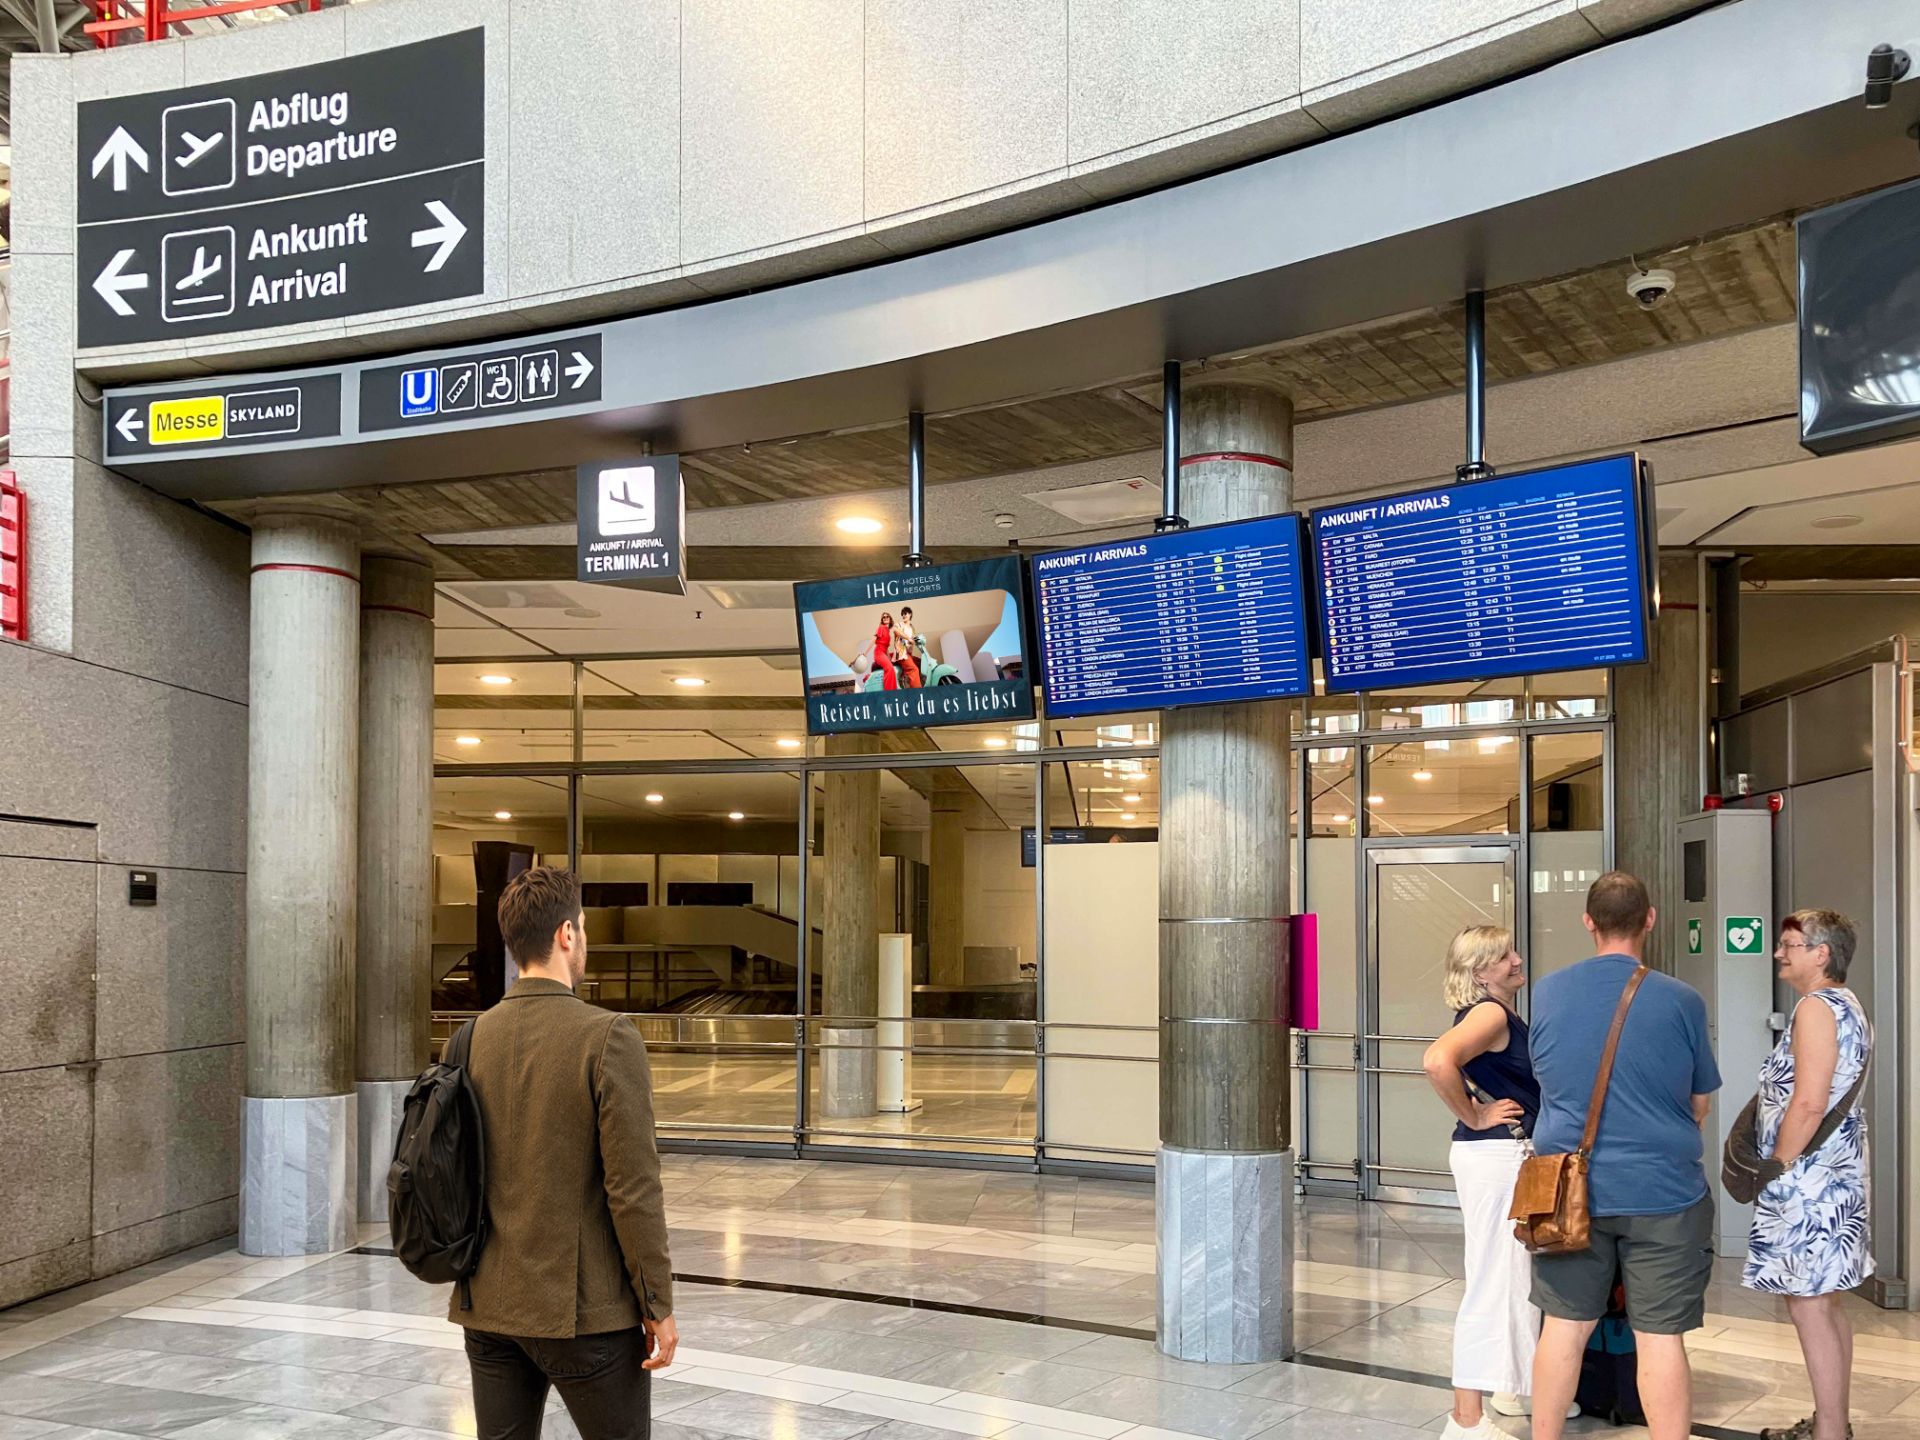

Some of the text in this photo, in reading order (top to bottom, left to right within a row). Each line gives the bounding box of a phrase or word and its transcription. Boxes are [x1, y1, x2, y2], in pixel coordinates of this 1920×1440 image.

[248, 92, 348, 132] Abflug
[247, 127, 397, 177] Departure
[248, 213, 368, 261] Ankunft
[248, 263, 347, 307] Arrival
[486, 366, 500, 375] WC
[407, 372, 432, 405] U
[157, 413, 218, 432] Messe
[230, 404, 295, 422] SKYLAND
[1320, 507, 1377, 528] ANKUNFT
[1386, 495, 1450, 517] ARRIVALS
[590, 541, 626, 552] ANKUNFT
[631, 538, 664, 549] ARRIVAL
[585, 552, 669, 573] TERMINAL 1
[1039, 554, 1087, 570] ANKUNFT
[1094, 545, 1147, 562] ARRIVALS
[867, 580, 899, 598] IHG
[903, 575, 933, 585] HOTELS
[903, 584, 941, 594] RESORTS
[820, 687, 1017, 723] Reisen, wie du es liebst
